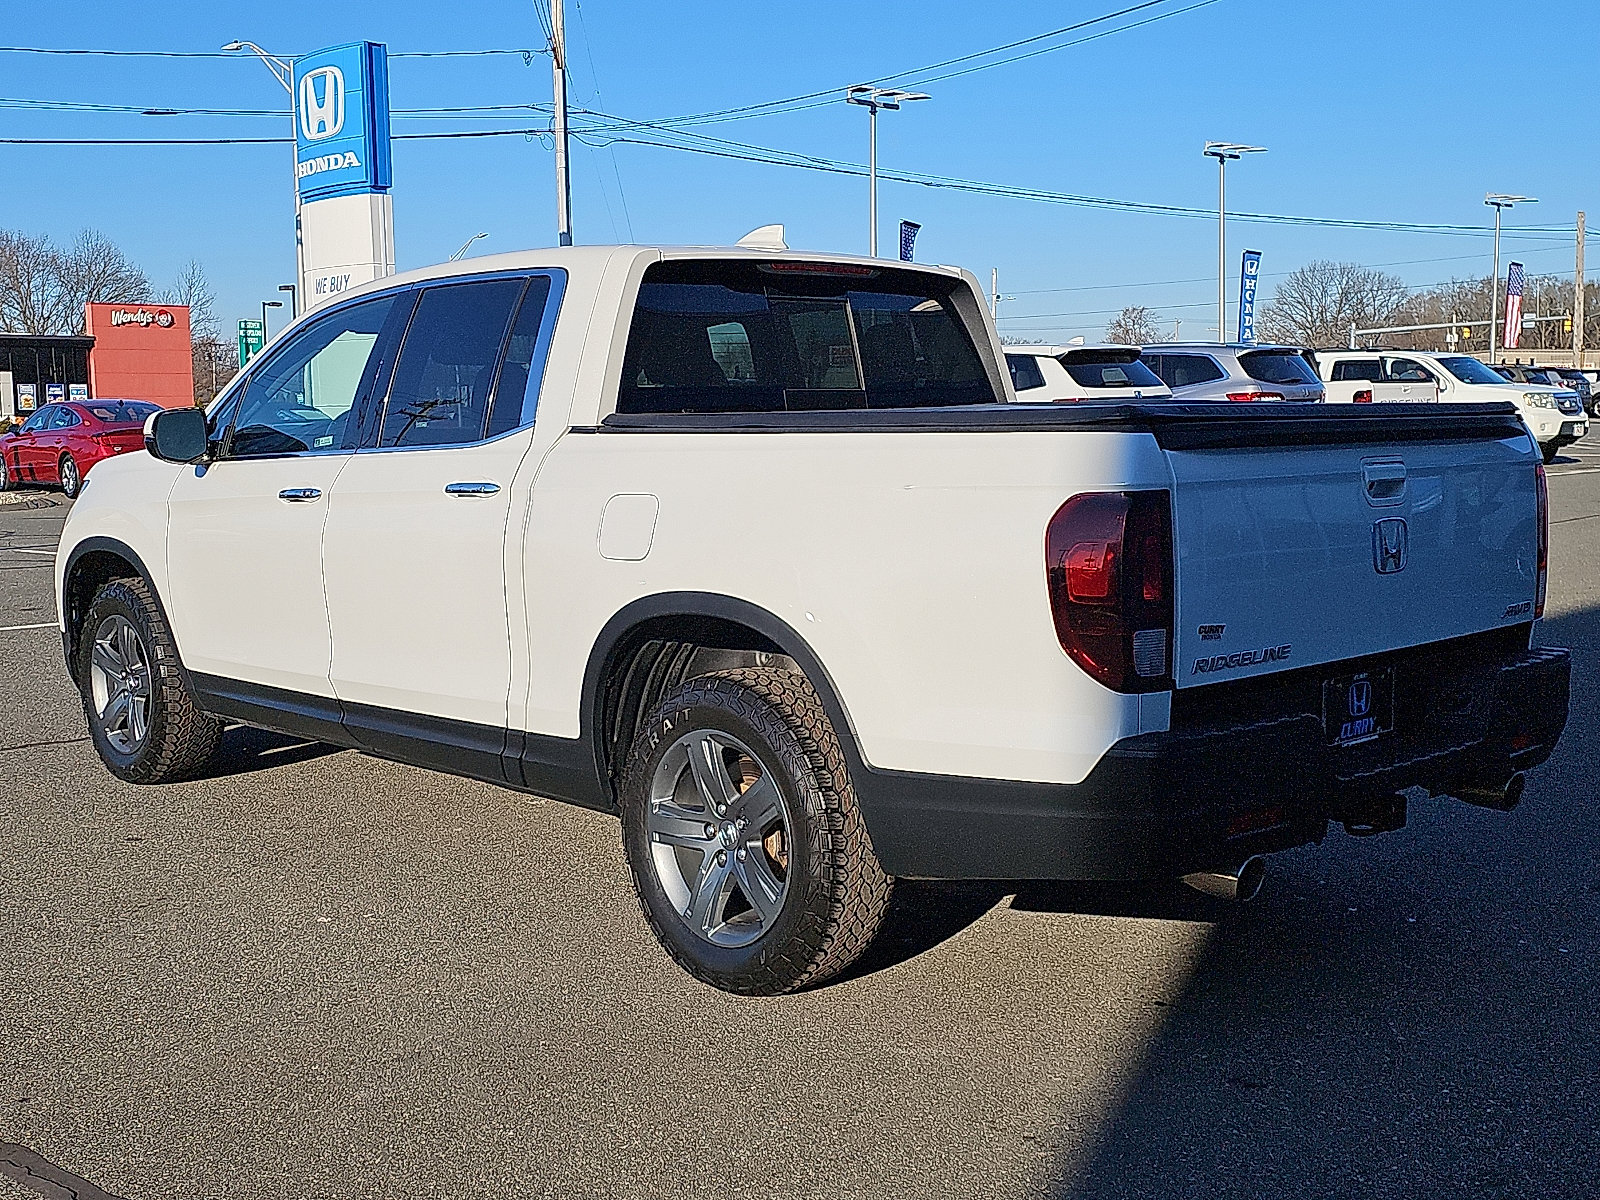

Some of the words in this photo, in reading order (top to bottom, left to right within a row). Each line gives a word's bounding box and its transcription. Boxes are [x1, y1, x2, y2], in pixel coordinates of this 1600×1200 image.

[298, 151, 362, 178] HONDA
[315, 277, 328, 294] WE
[330, 274, 350, 292] BUY
[111, 307, 153, 326] Wendy's
[1243, 278, 1257, 339] HONDA
[1198, 624, 1226, 635] CURRY
[1191, 643, 1292, 675] RIDGELINE
